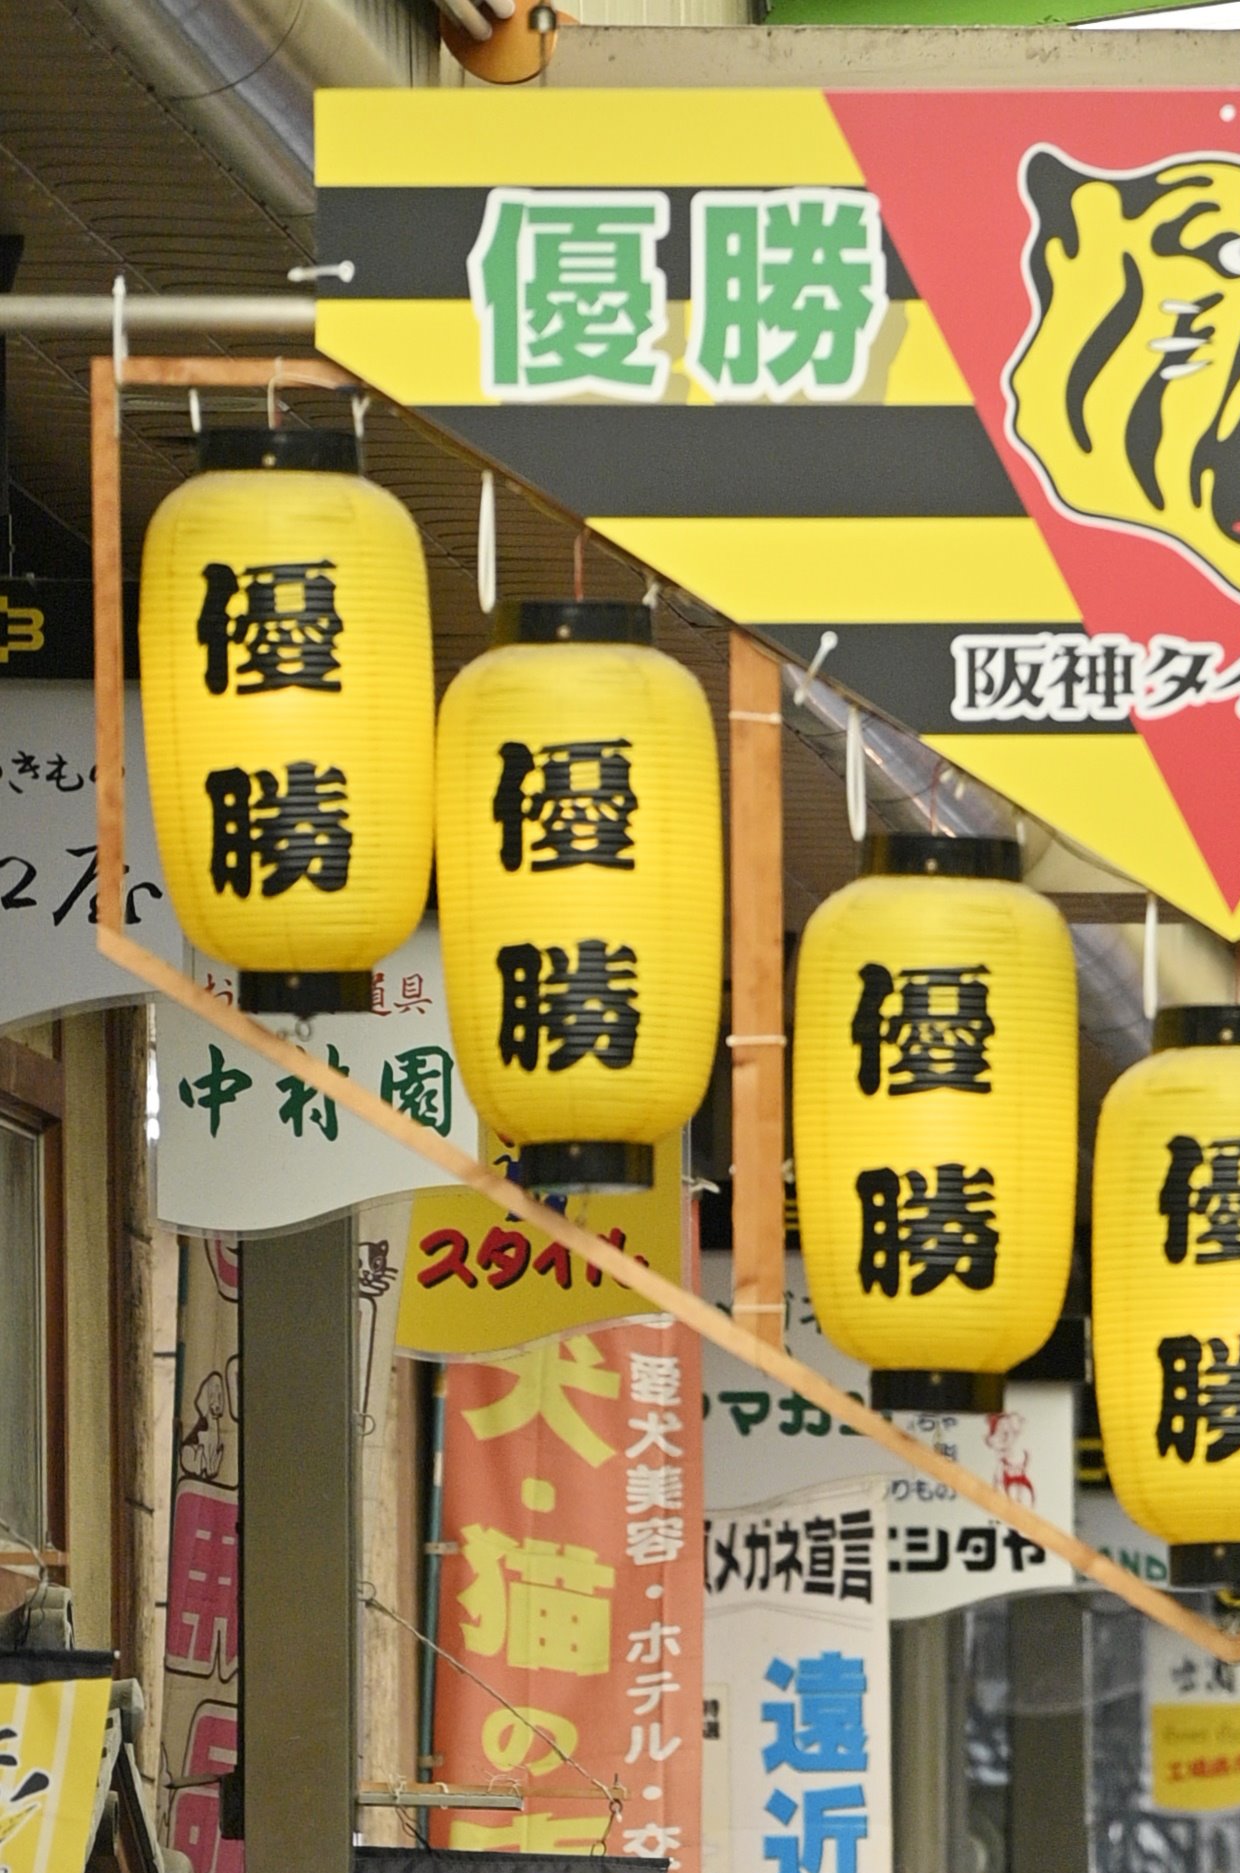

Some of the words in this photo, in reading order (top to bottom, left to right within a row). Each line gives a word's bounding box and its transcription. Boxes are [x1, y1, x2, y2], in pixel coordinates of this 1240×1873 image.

[470, 188, 884, 400] 優勝
[197, 559, 354, 898] 優勝
[492, 739, 641, 1072] 優勝
[179, 1043, 454, 1141] 中村園
[851, 962, 1000, 1298] 優勝
[704, 1510, 874, 1604] メガネ宣言
